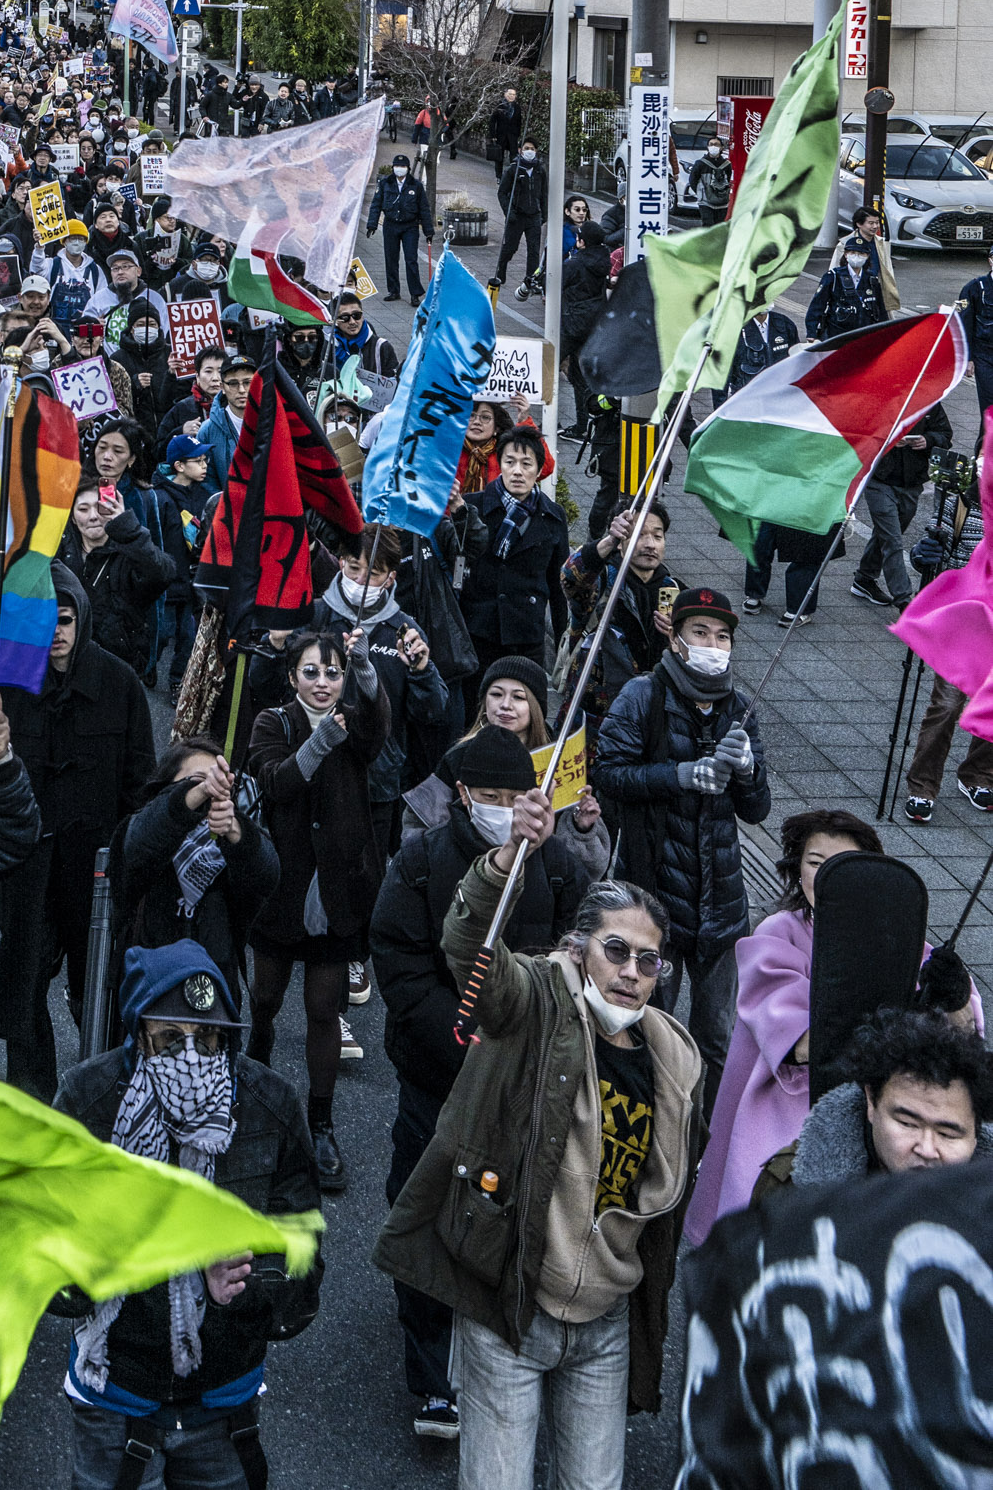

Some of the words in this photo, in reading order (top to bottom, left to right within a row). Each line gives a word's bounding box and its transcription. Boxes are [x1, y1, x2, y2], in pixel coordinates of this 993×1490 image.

[848, 67, 865, 75] IN
[641, 93, 661, 179] 毘沙門天
[35, 200, 61, 216] この街に
[37, 212, 64, 227] ヘイトは
[39, 227, 66, 241] いらない
[961, 231, 982, 239] 53-97
[170, 302, 213, 323] STOP
[173, 322, 218, 343] ZERO
[60, 365, 101, 391] さべつ
[485, 378, 539, 394] DHEVAL
